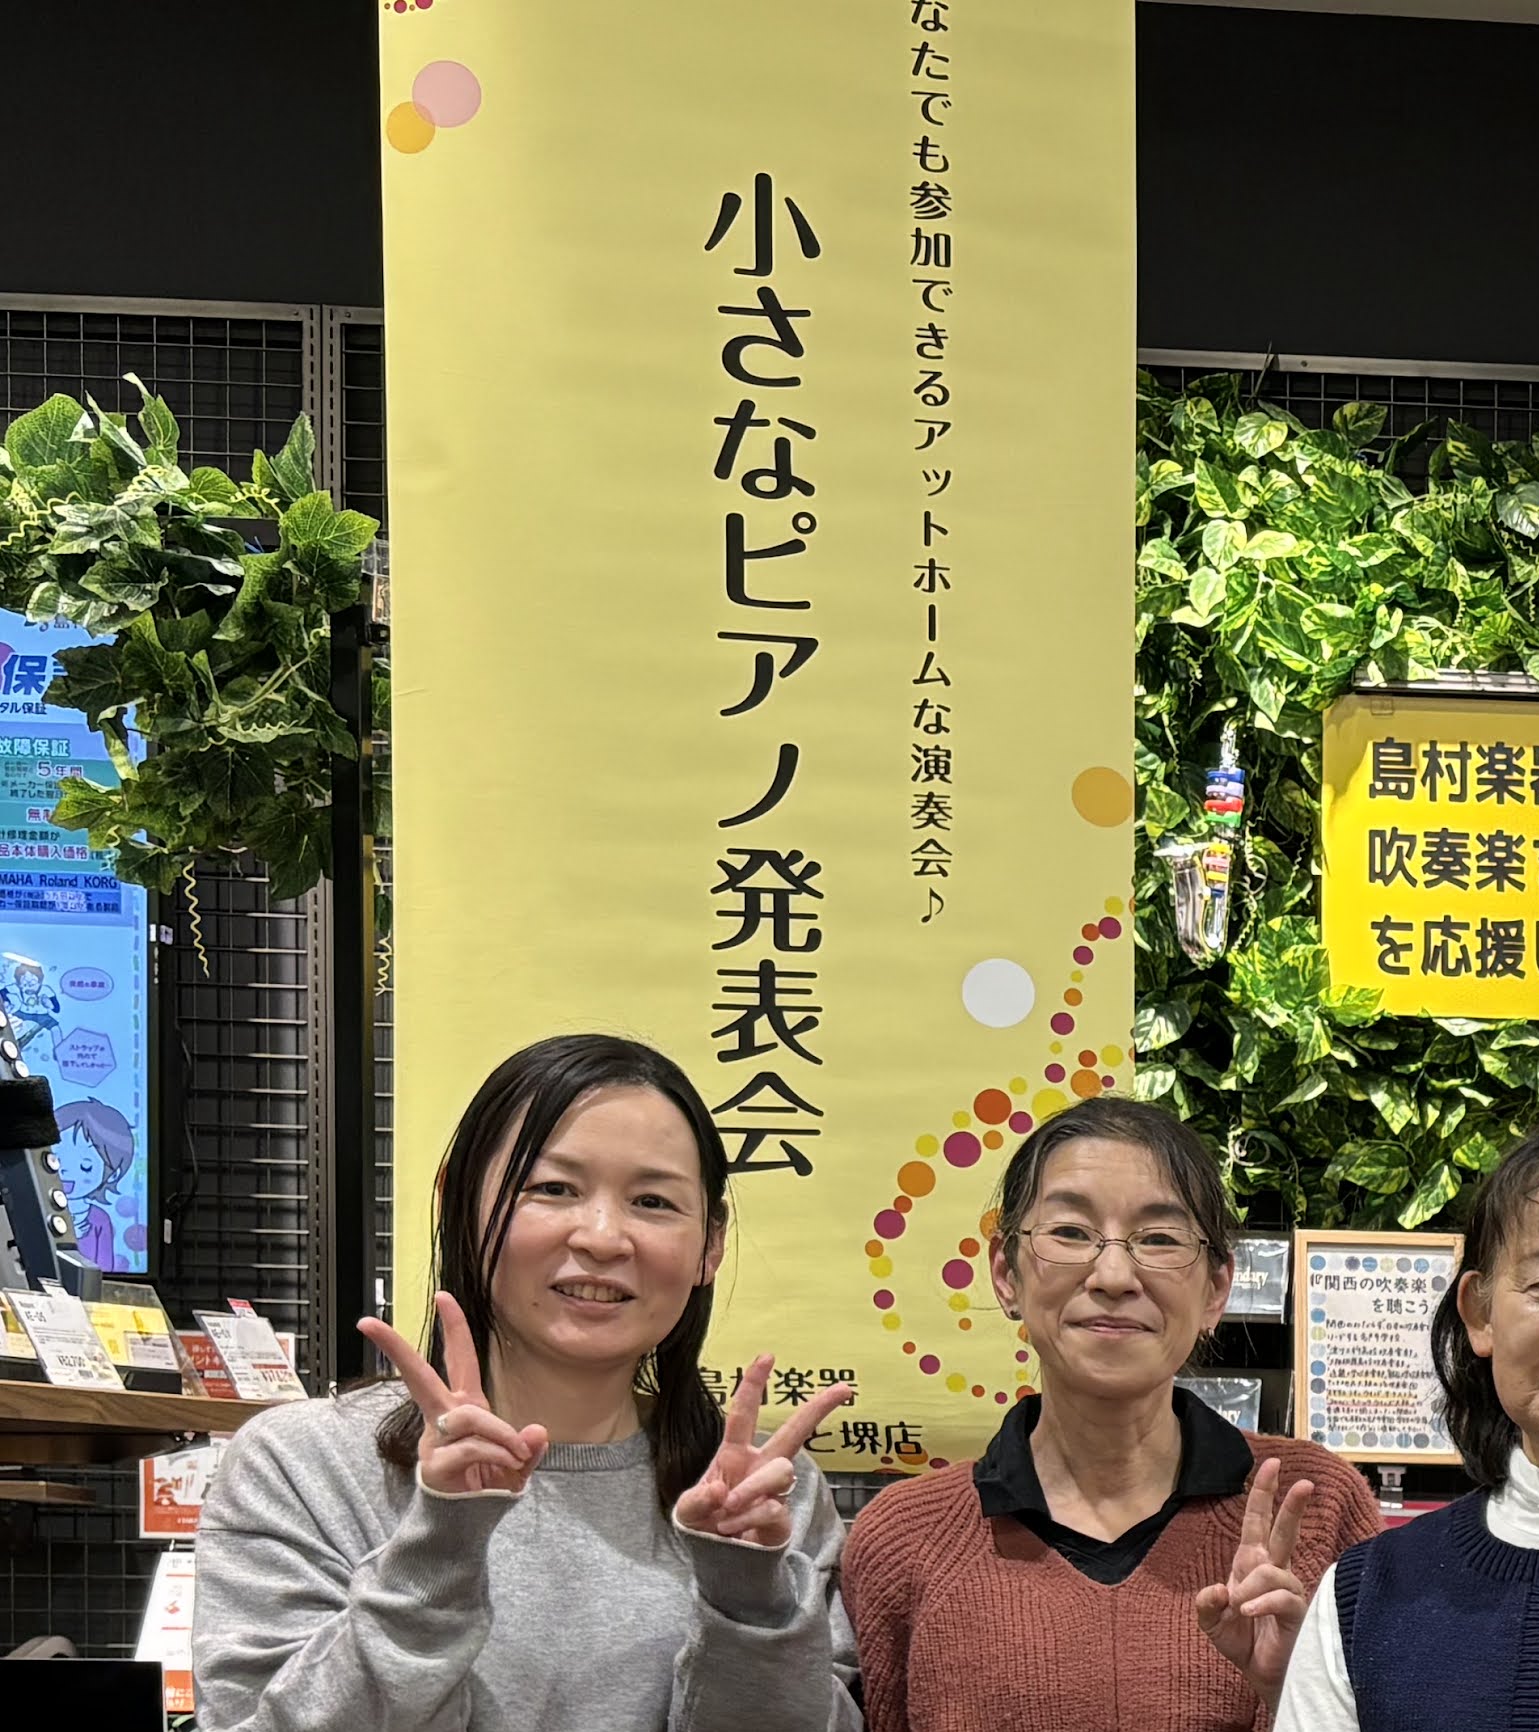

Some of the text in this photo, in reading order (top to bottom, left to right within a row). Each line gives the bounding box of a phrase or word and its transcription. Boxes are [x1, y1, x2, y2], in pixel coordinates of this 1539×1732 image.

[84, 876, 118, 889] KORG
[704, 172, 824, 1177] 小さなピアノ発表会
